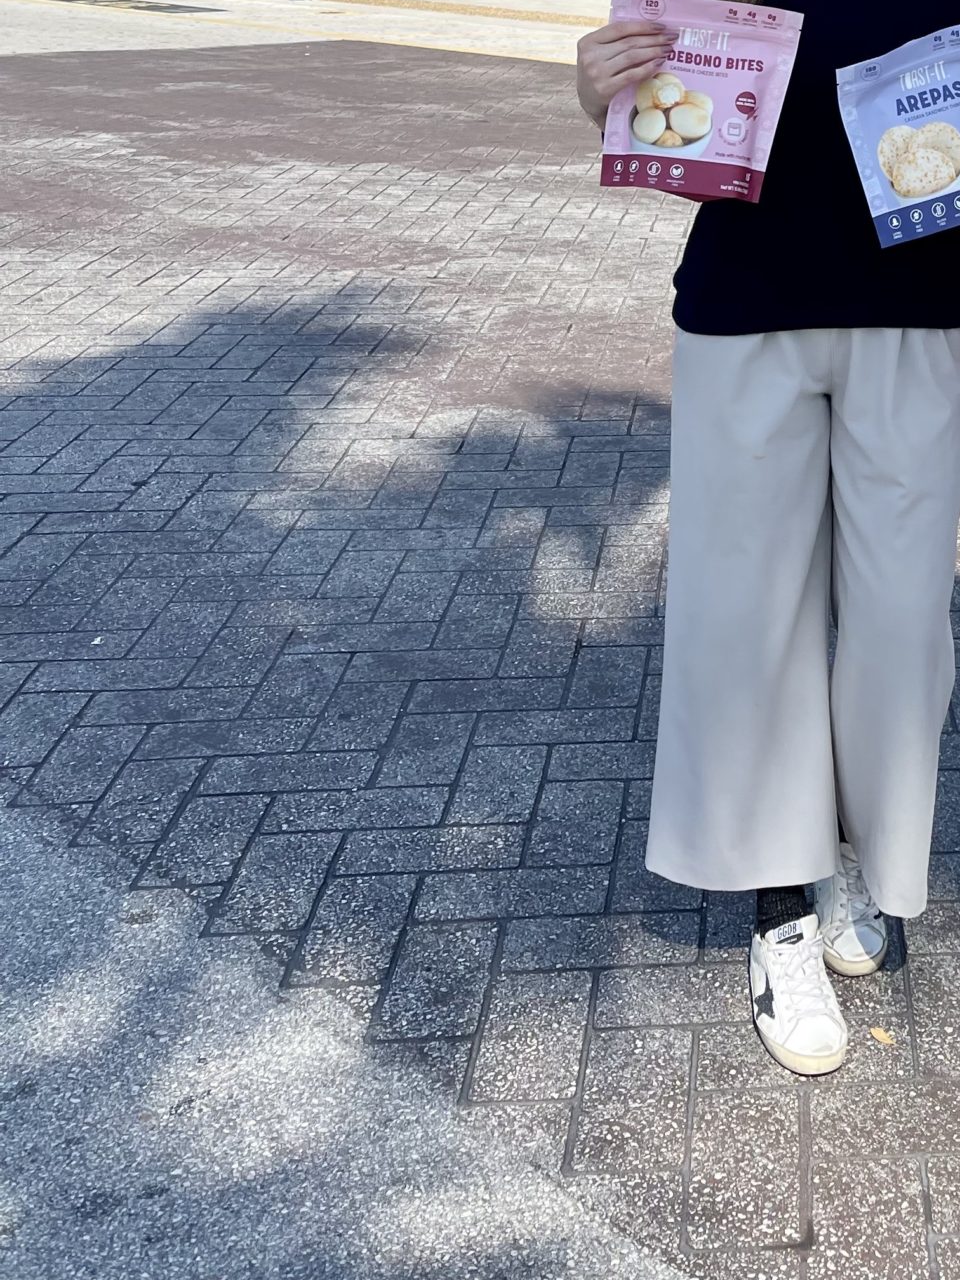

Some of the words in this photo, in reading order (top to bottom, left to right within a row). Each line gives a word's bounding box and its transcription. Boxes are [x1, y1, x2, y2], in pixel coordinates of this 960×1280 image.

[646, 0, 659, 8] 120
[667, 50, 722, 68] DEBONO
[726, 58, 764, 72] BITES
[778, 922, 797, 940] GGDB
